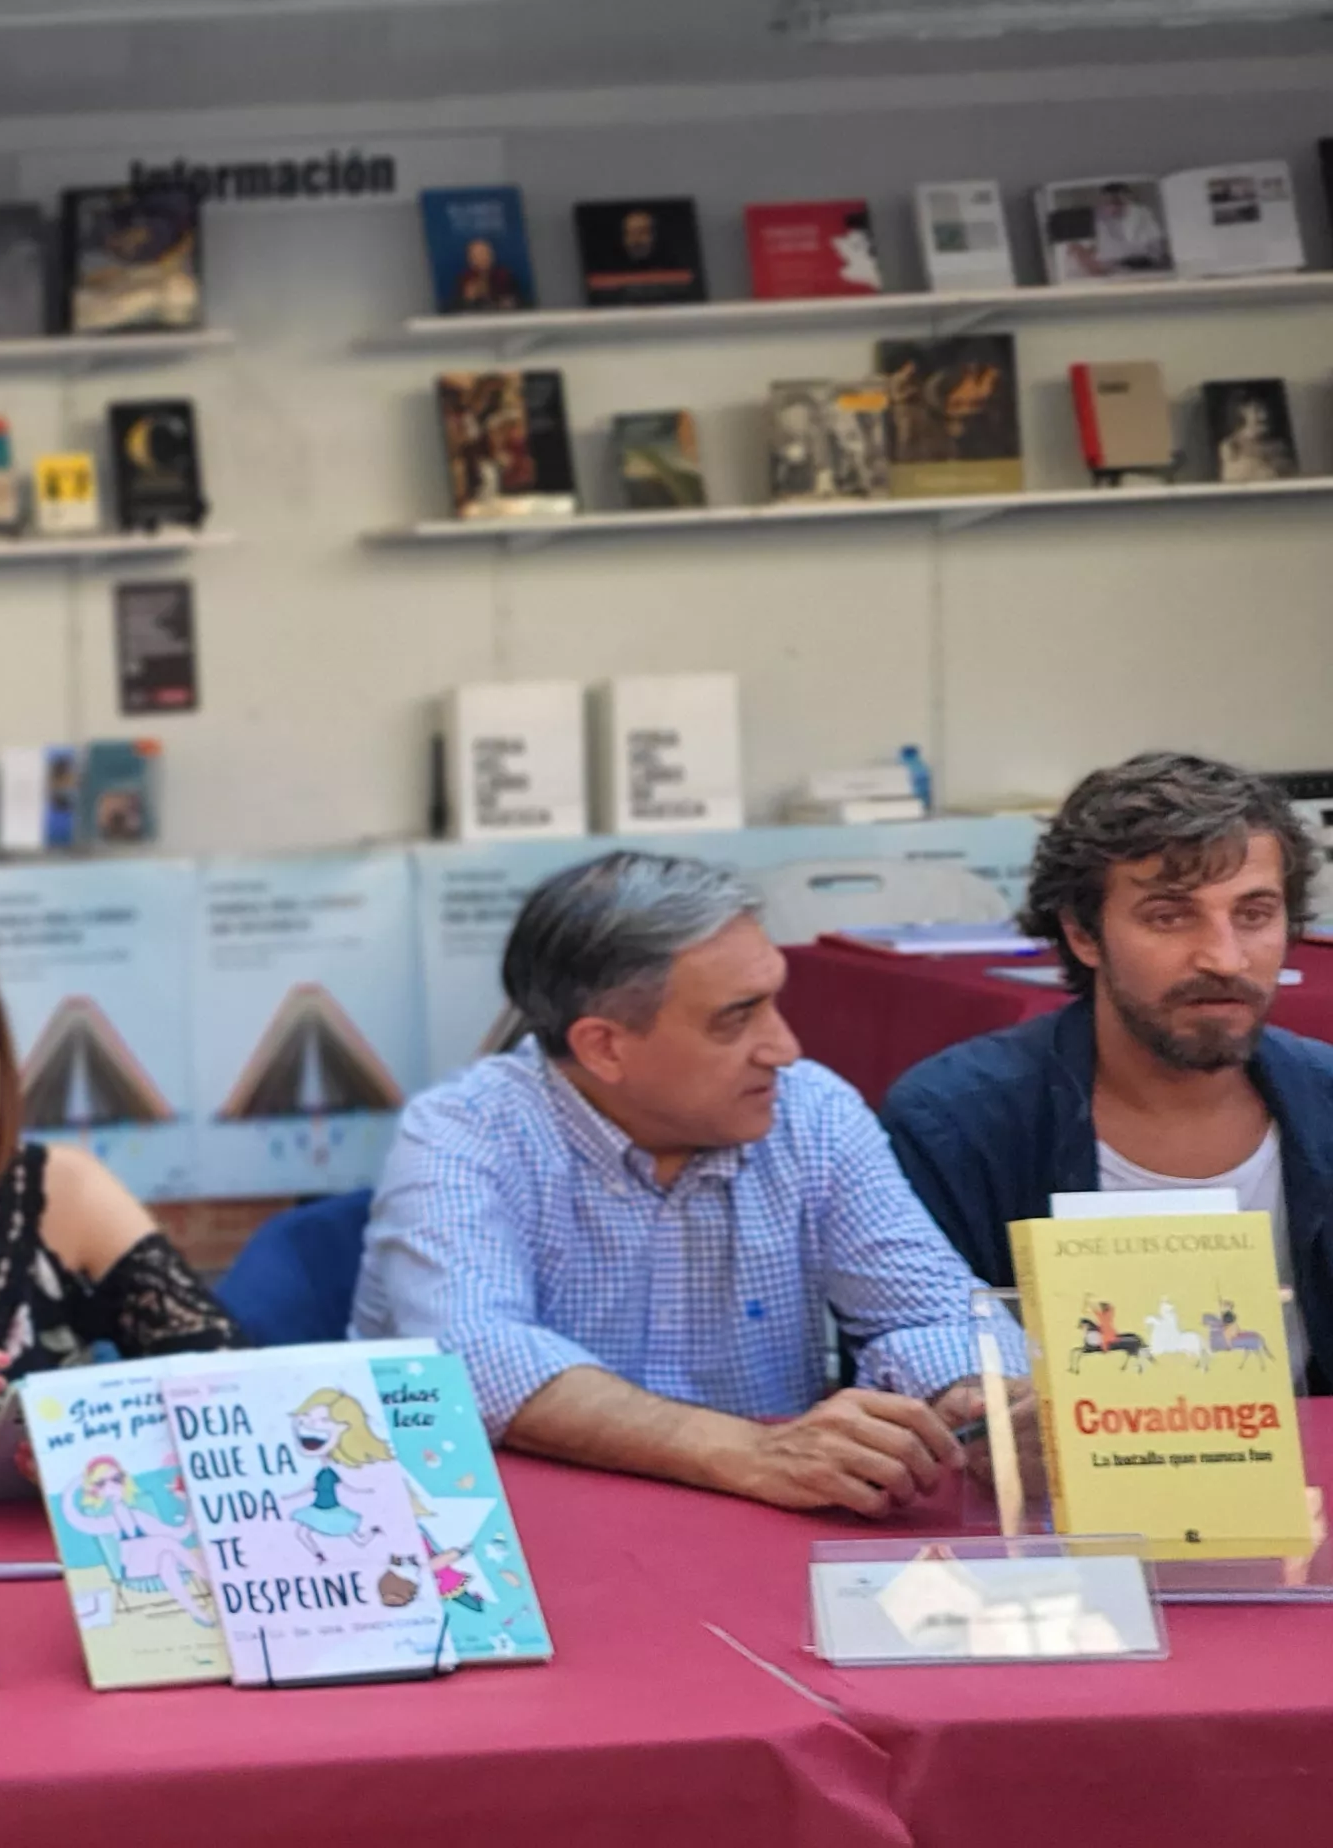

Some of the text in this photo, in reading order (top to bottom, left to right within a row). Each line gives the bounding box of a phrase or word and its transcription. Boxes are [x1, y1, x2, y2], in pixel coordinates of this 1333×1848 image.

[129, 147, 396, 204] Información
[1114, 1236, 1161, 1254] LUIS
[1165, 1232, 1256, 1253] CORRAL
[174, 1404, 253, 1441] DEJA
[1074, 1396, 1281, 1439] Covadonga
[190, 1443, 298, 1480] QUE LA
[1169, 1452, 1196, 1469] que
[199, 1489, 282, 1524] VIDA
[210, 1536, 248, 1570] TE
[221, 1571, 369, 1614] DESPEINE
